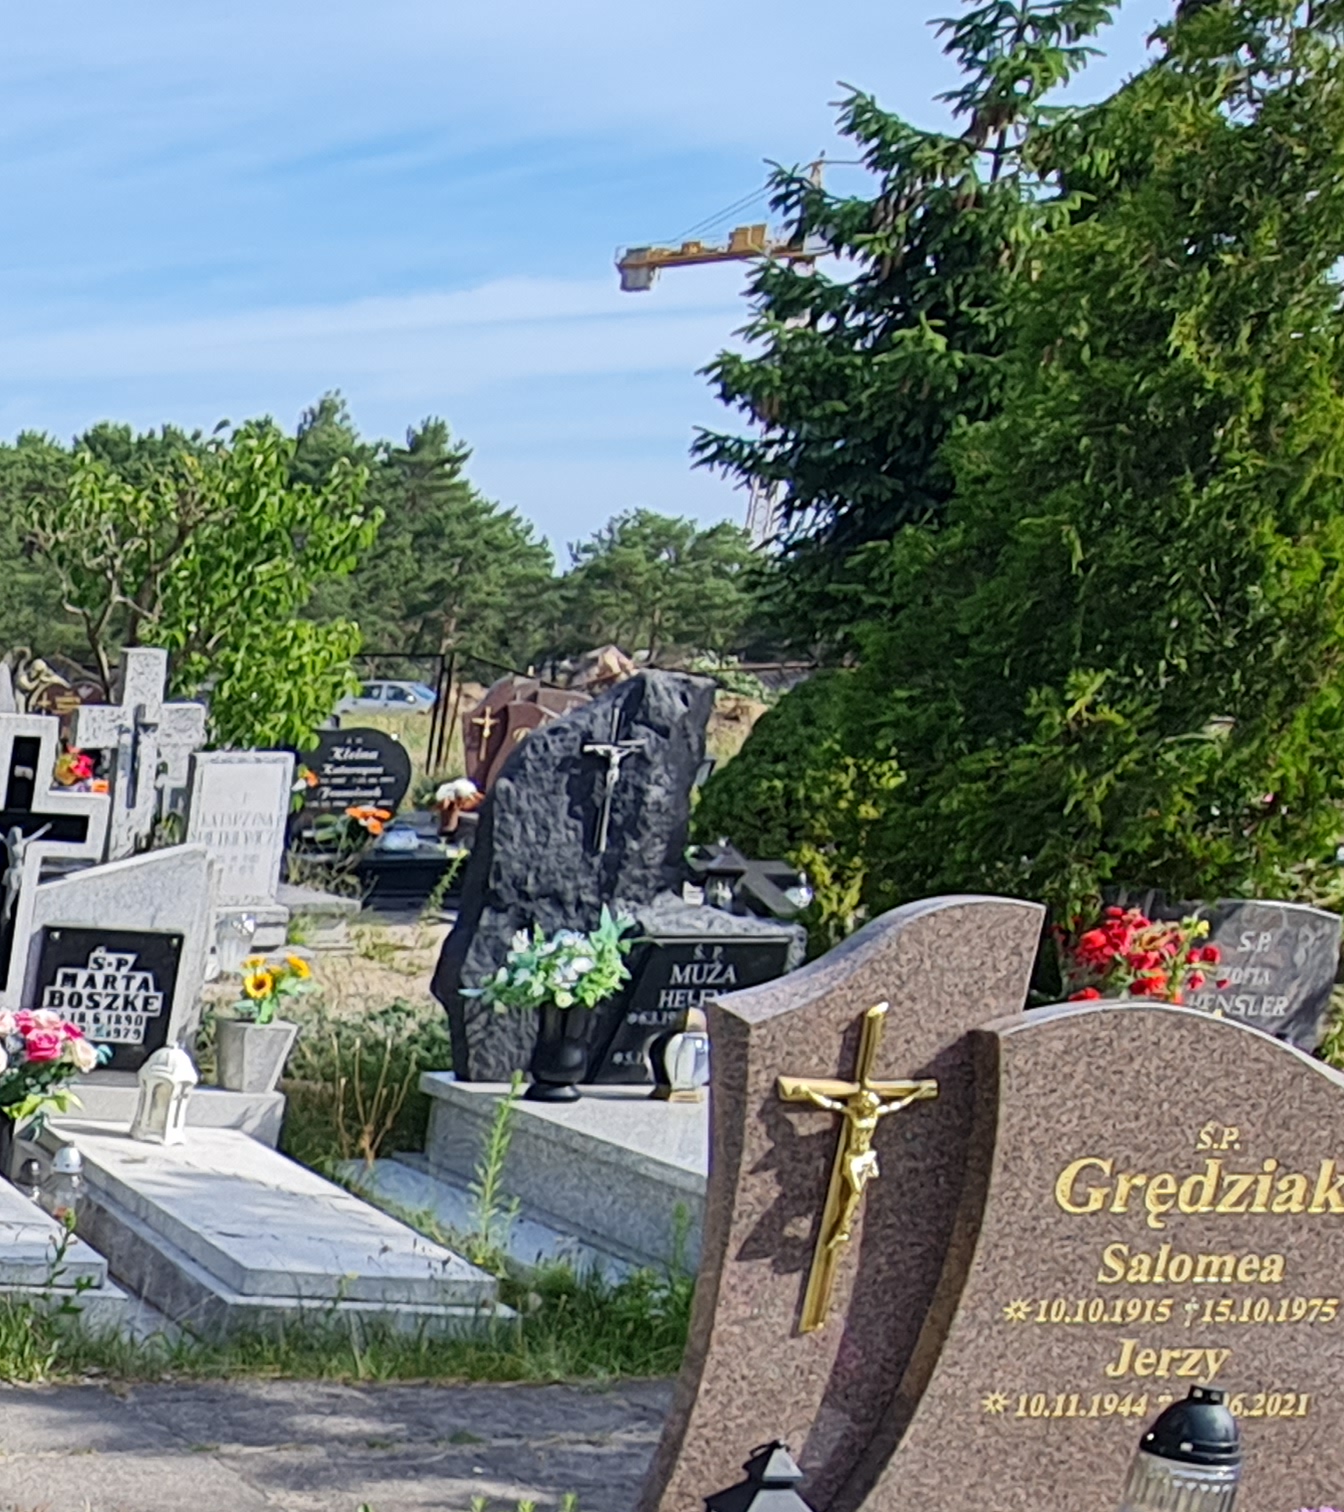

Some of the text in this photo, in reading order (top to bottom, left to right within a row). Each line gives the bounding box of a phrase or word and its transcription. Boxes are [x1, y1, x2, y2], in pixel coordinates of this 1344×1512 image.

[60, 972, 151, 993] MARTA
[47, 990, 160, 1013] BOSZKE
[1054, 1155, 1344, 1229] Grędziak
[1097, 1242, 1286, 1284] Salomea
[1034, 1298, 1340, 1323] 10.10.1915 15.10.1975
[1105, 1338, 1232, 1383] Jerzy
[1014, 1393, 1149, 1418] 10.11.1944
